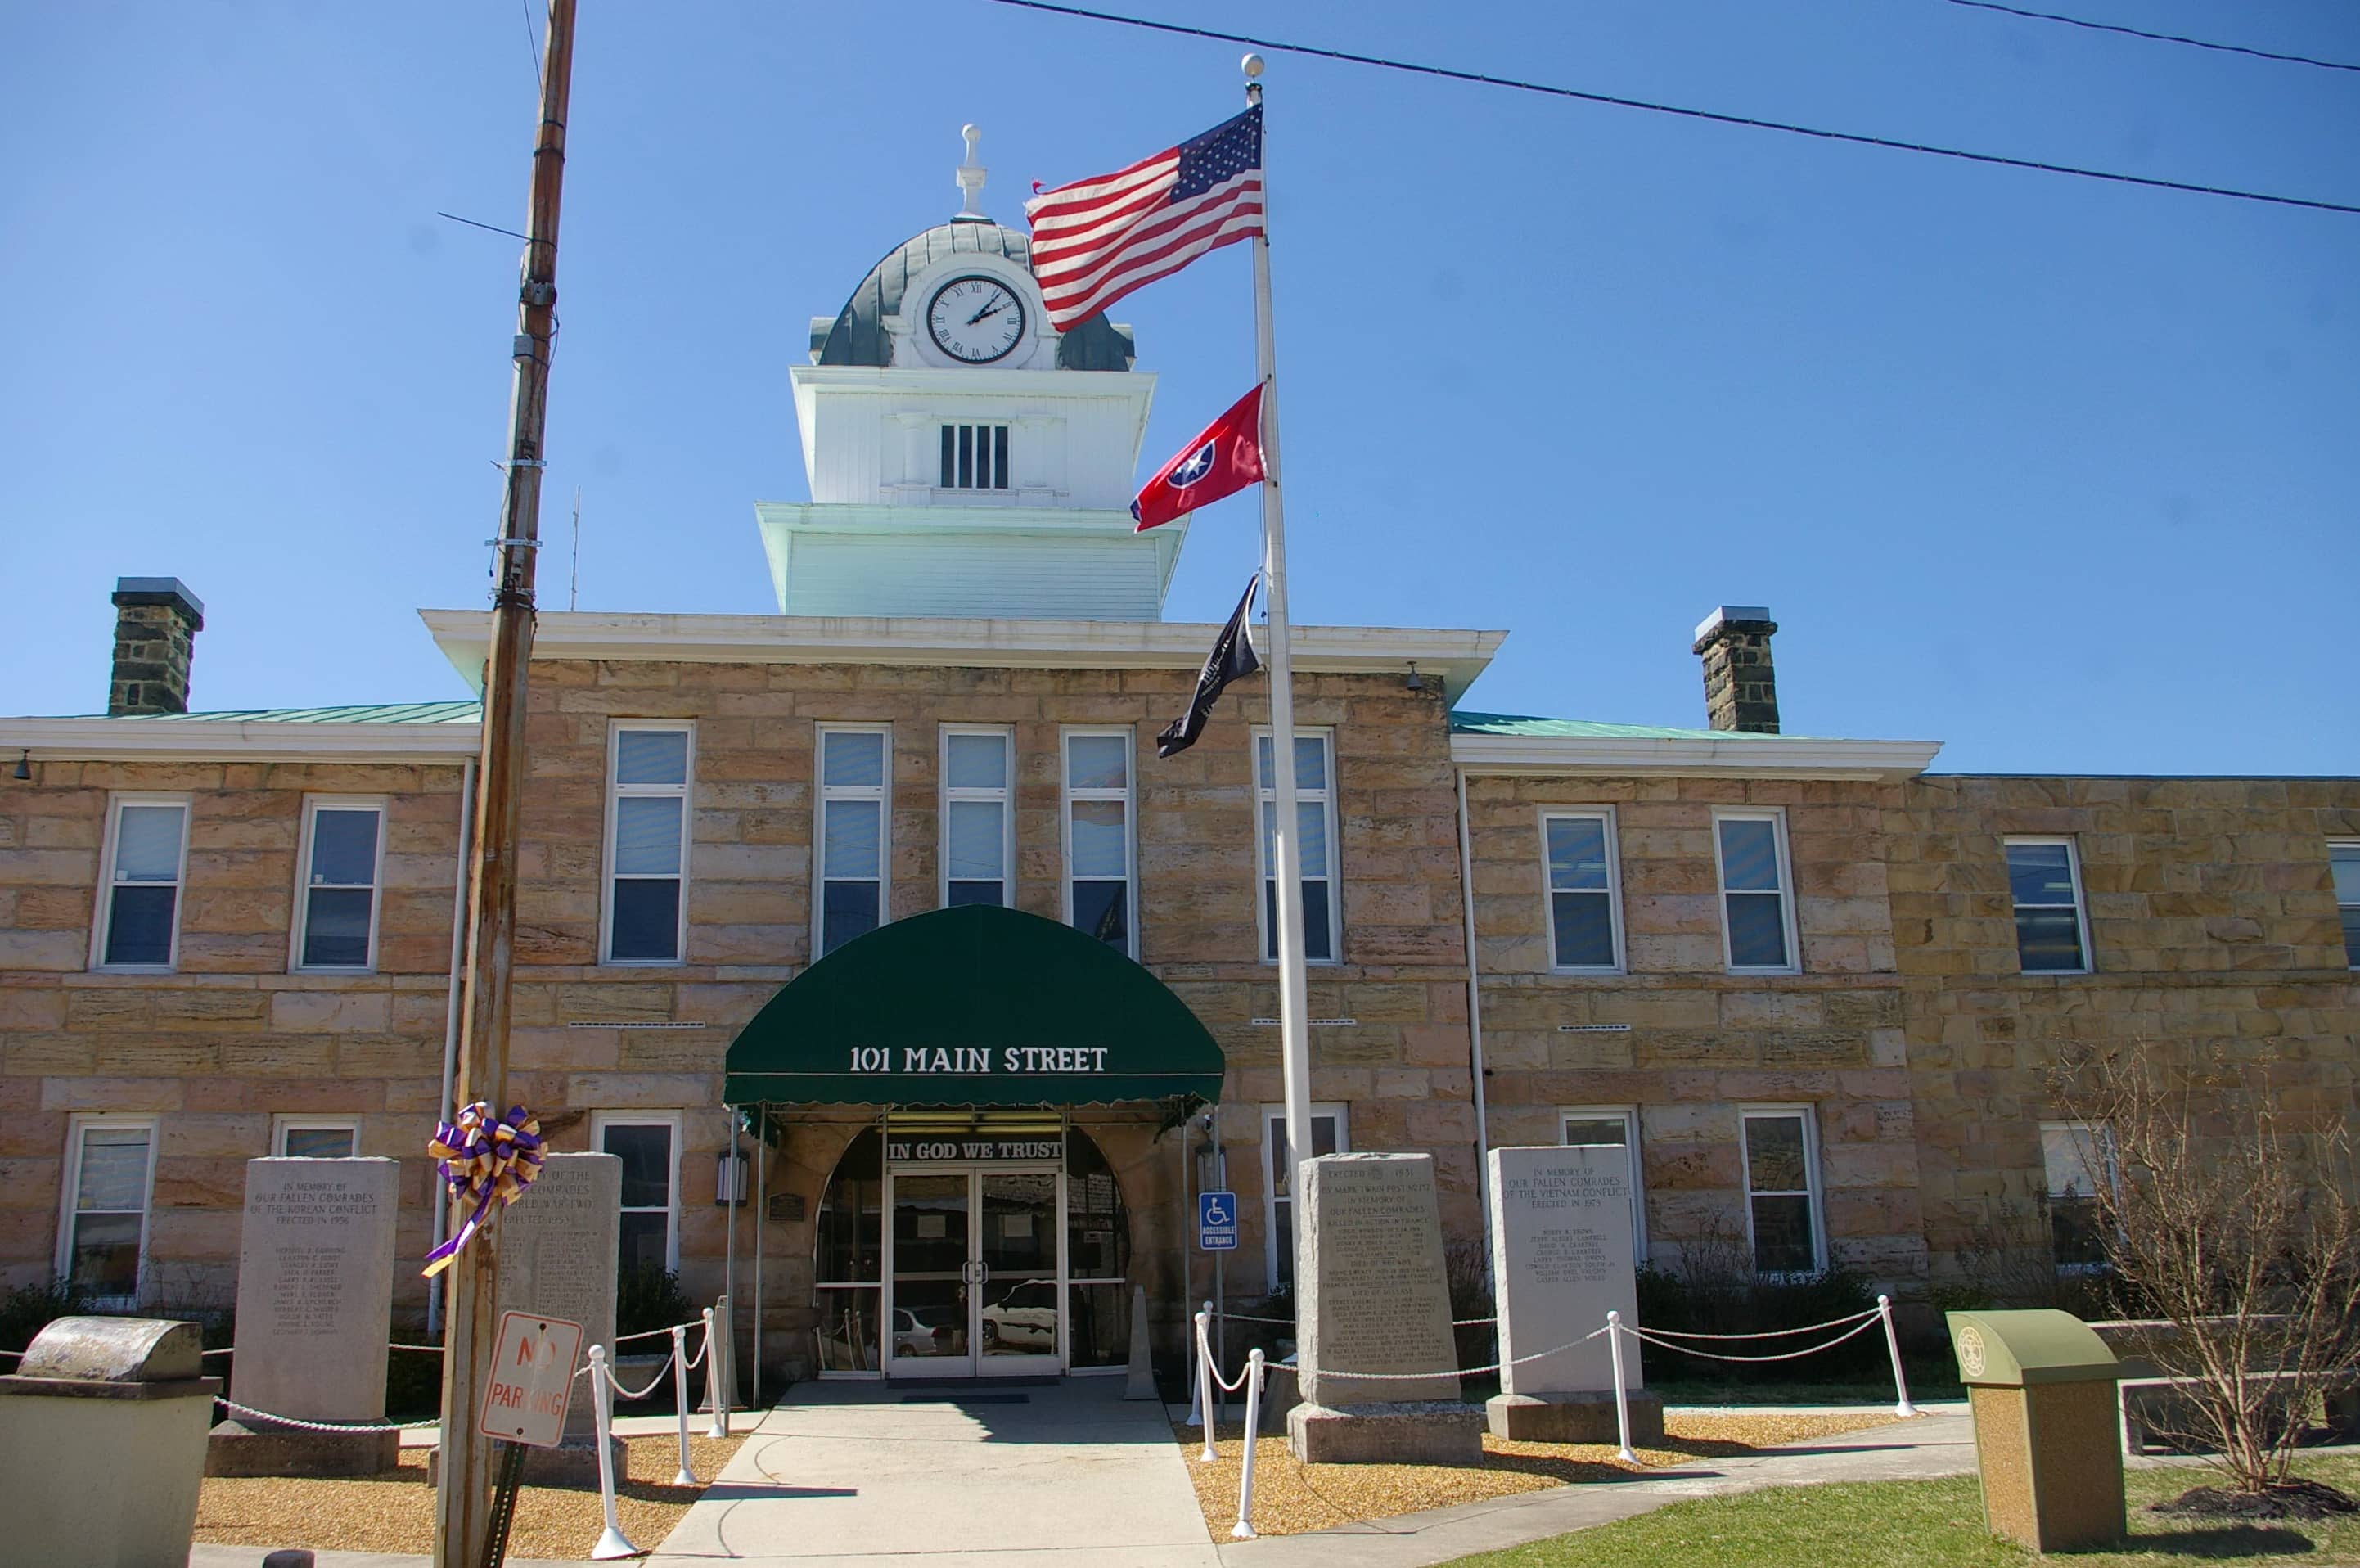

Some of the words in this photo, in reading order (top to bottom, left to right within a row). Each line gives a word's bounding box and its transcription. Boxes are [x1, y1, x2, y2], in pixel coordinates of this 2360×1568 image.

[851, 1047, 890, 1072] 101
[903, 1047, 992, 1073] MAIN
[1003, 1047, 1108, 1072] STREET
[888, 1142, 910, 1160] IN
[916, 1142, 957, 1160] GOD
[962, 1142, 993, 1159] WE
[998, 1142, 1062, 1159] TRUST
[571, 1171, 590, 1180] THE
[1329, 1170, 1365, 1178] ERECTED
[1534, 1168, 1542, 1176] IN
[1547, 1168, 1579, 1176] MEMORY
[1584, 1167, 1594, 1175] OF
[1509, 1179, 1528, 1188] OUR
[1533, 1178, 1565, 1187] FALLEN
[1570, 1177, 1620, 1187] COMRADES
[529, 1184, 590, 1195] COMRADES
[1360, 1185, 1384, 1193] TWAIN
[1503, 1190, 1513, 1199] OF
[1520, 1190, 1538, 1198] THE
[1541, 1188, 1579, 1198] VIETNAM
[1583, 1187, 1628, 1197] CONFLICT
[255, 1192, 277, 1203] OUR
[280, 1192, 315, 1202] FALLEN
[319, 1192, 374, 1203] COMRADES
[508, 1199, 538, 1209] ORLD
[543, 1199, 563, 1209] WAR
[1532, 1200, 1566, 1209] ERECTED
[1571, 1199, 1579, 1207] IN
[268, 1205, 284, 1214] THE
[288, 1205, 326, 1214] KOREAN
[329, 1205, 379, 1214] CONFLICT
[1349, 1207, 1377, 1215] FALLEN
[276, 1216, 314, 1224] ERECTED
[1203, 1226, 1235, 1234] ACCESSIBLE
[1205, 1236, 1232, 1244] ENTRANCE
[491, 1383, 562, 1416] PARING
